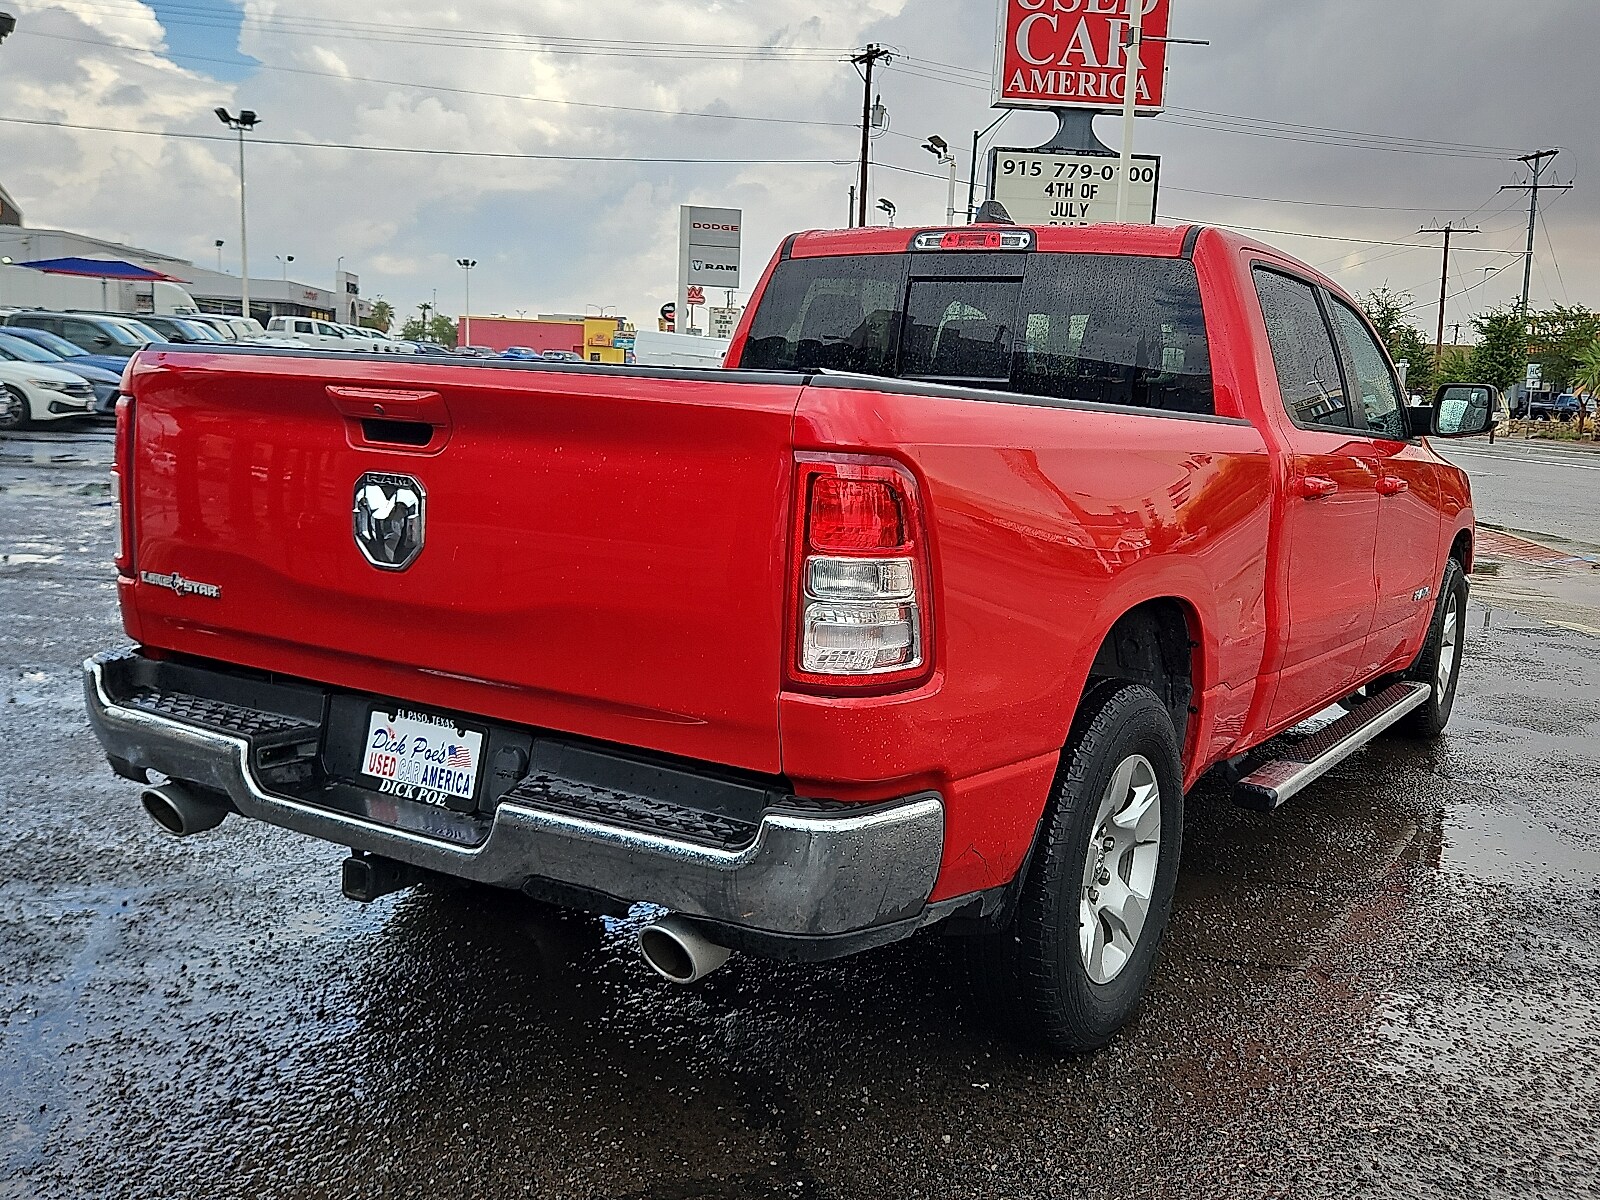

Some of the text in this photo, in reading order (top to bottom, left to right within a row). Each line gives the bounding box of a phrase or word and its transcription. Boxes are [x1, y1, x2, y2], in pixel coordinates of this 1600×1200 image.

[1016, 12, 1147, 70] CAR
[1006, 68, 1151, 100] AMERICA
[1003, 159, 1154, 183] 915 779-000
[1044, 182, 1098, 199] 4TH OF
[1050, 202, 1089, 218] JULY
[692, 222, 739, 232] DODGE
[705, 263, 738, 272] RAM
[183, 580, 220, 598] STAR
[397, 708, 405, 719] EL
[431, 715, 455, 729] TEXAS
[371, 728, 447, 764] Dick Poe's
[368, 752, 470, 796] USED CAR AMERICA
[379, 778, 449, 807] DICK POE
